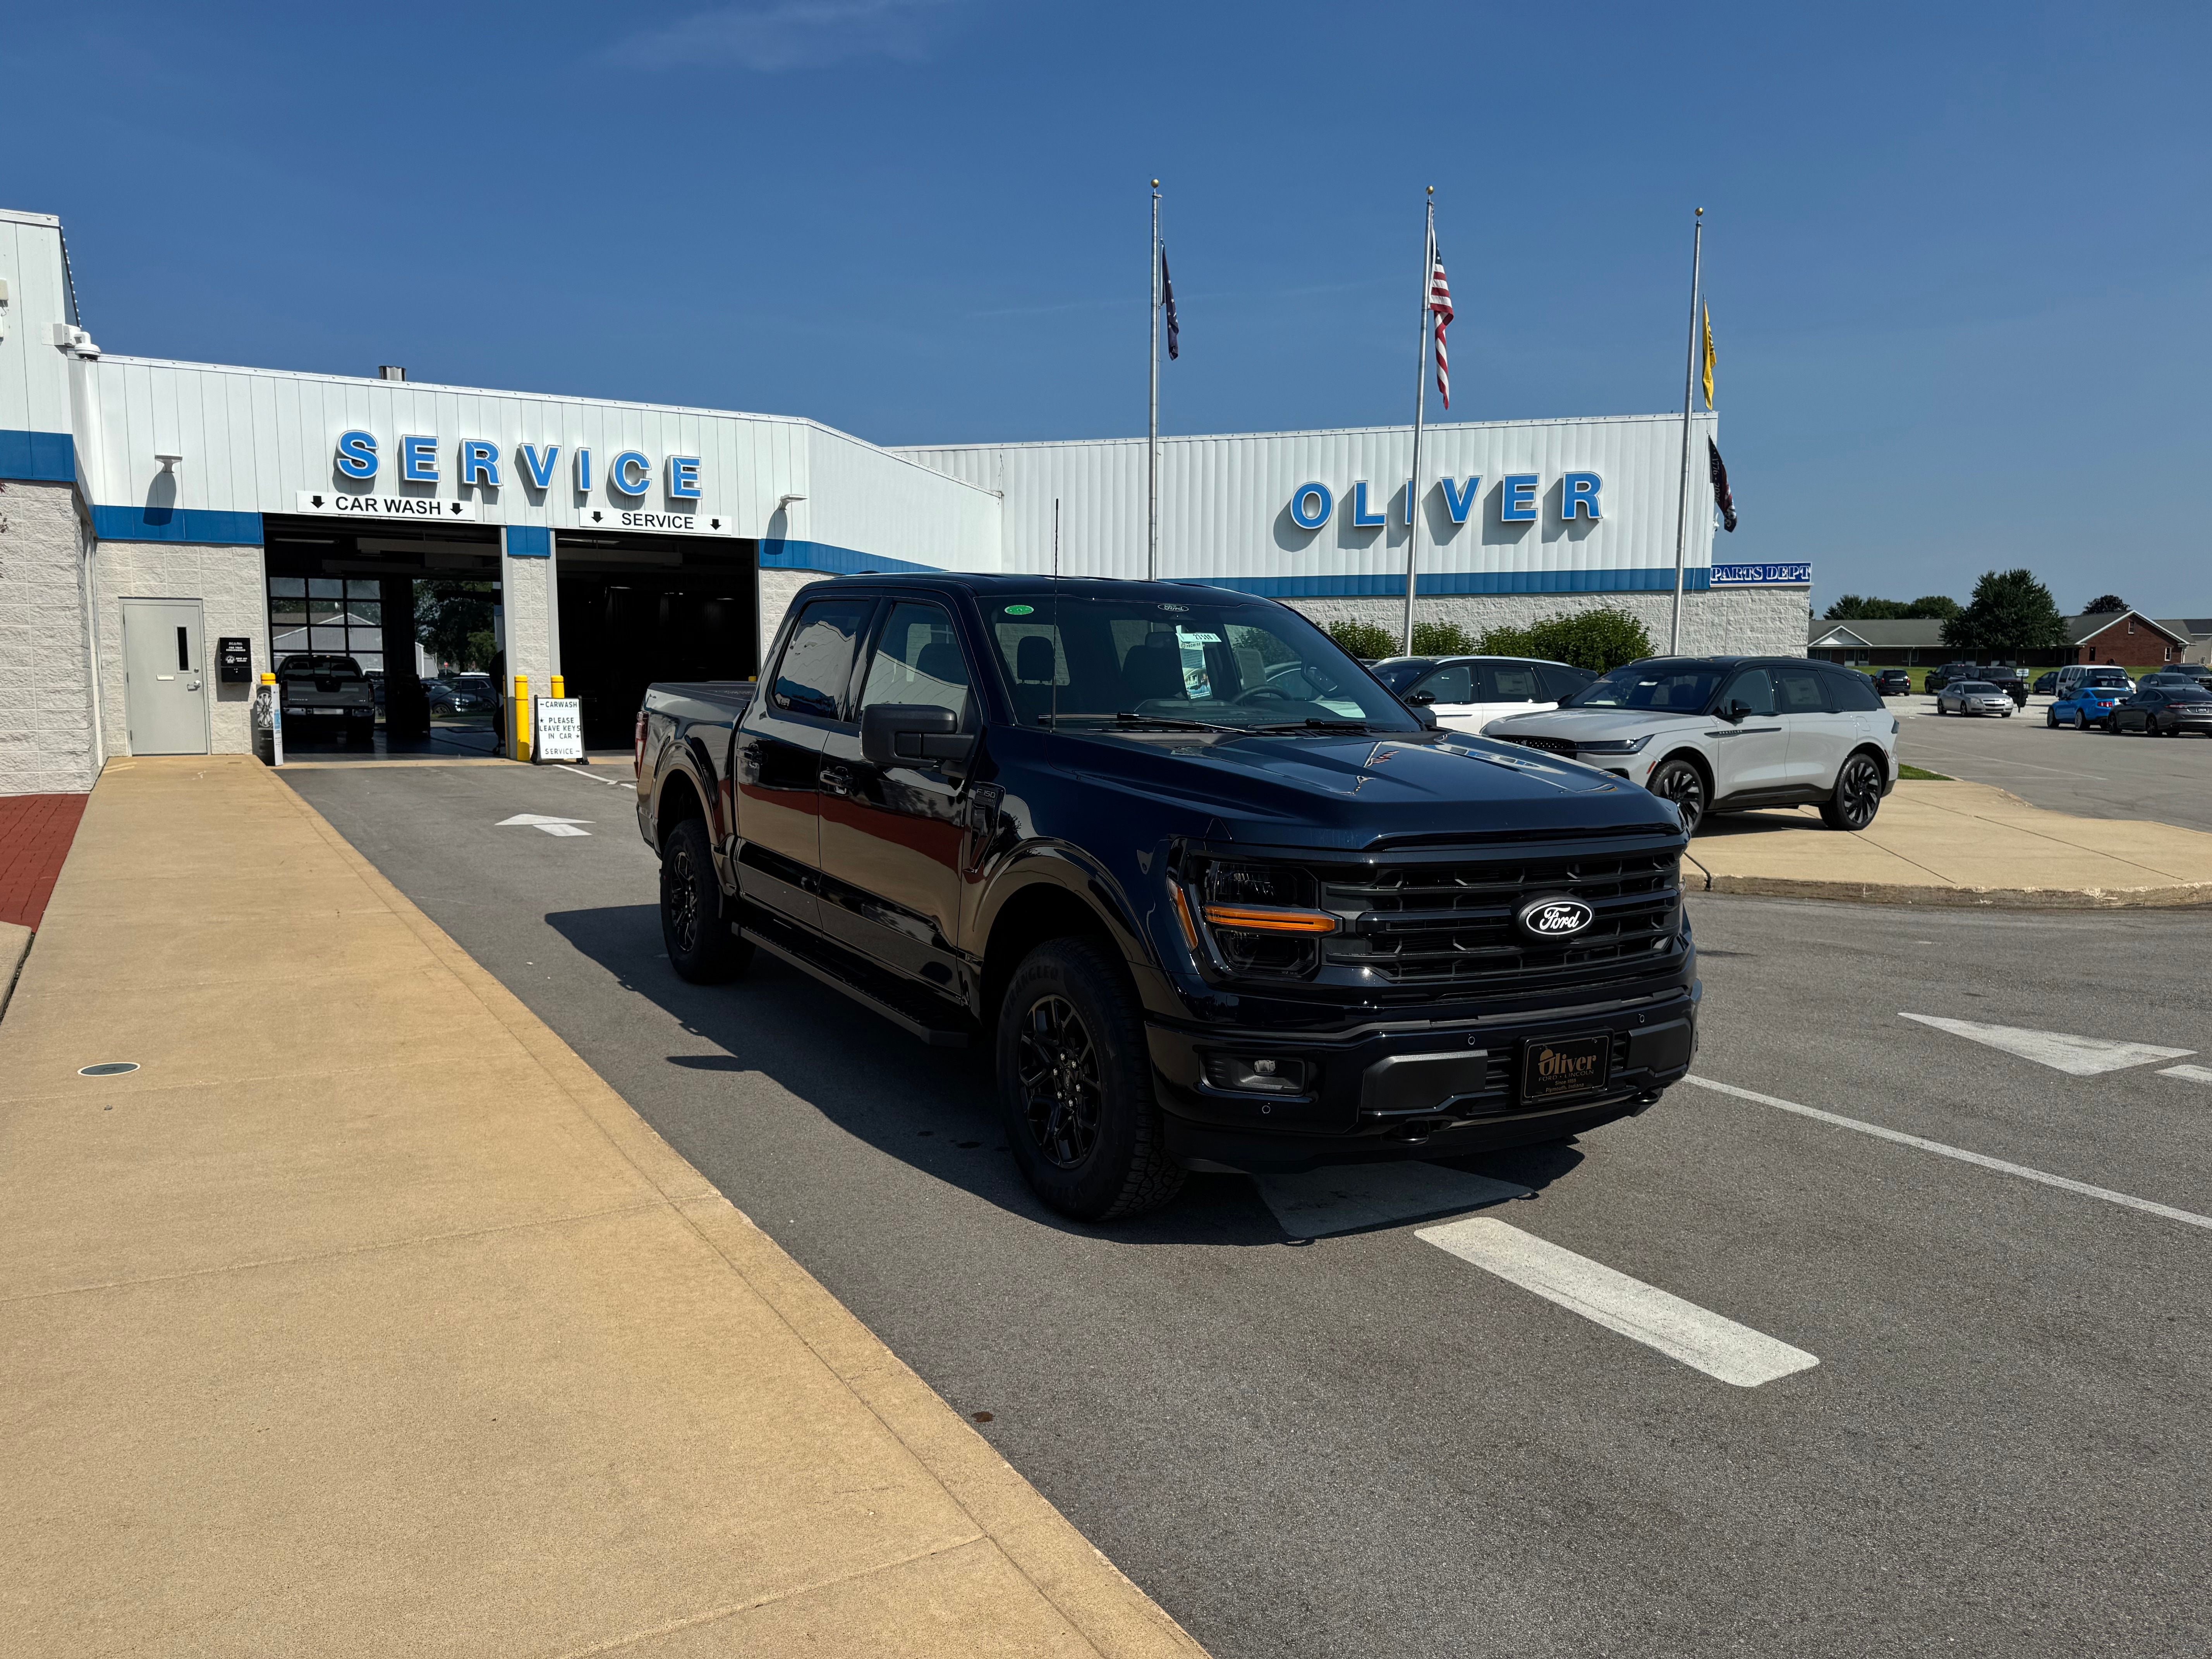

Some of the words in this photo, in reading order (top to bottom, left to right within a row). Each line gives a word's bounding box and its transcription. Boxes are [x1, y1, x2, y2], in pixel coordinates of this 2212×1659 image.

[337, 430, 703, 500] SERVICE
[335, 496, 377, 513] CAR
[384, 499, 441, 515] WASH
[621, 512, 694, 530] SERVICE
[1711, 567, 1763, 581] PARTS
[1766, 565, 1810, 580] DEPT
[1539, 907, 1580, 930] Ford
[1003, 965, 1059, 1020] WRANGLER
[1538, 1049, 1596, 1076] Oliver
[1565, 1070, 1594, 1079] LINCOLN
